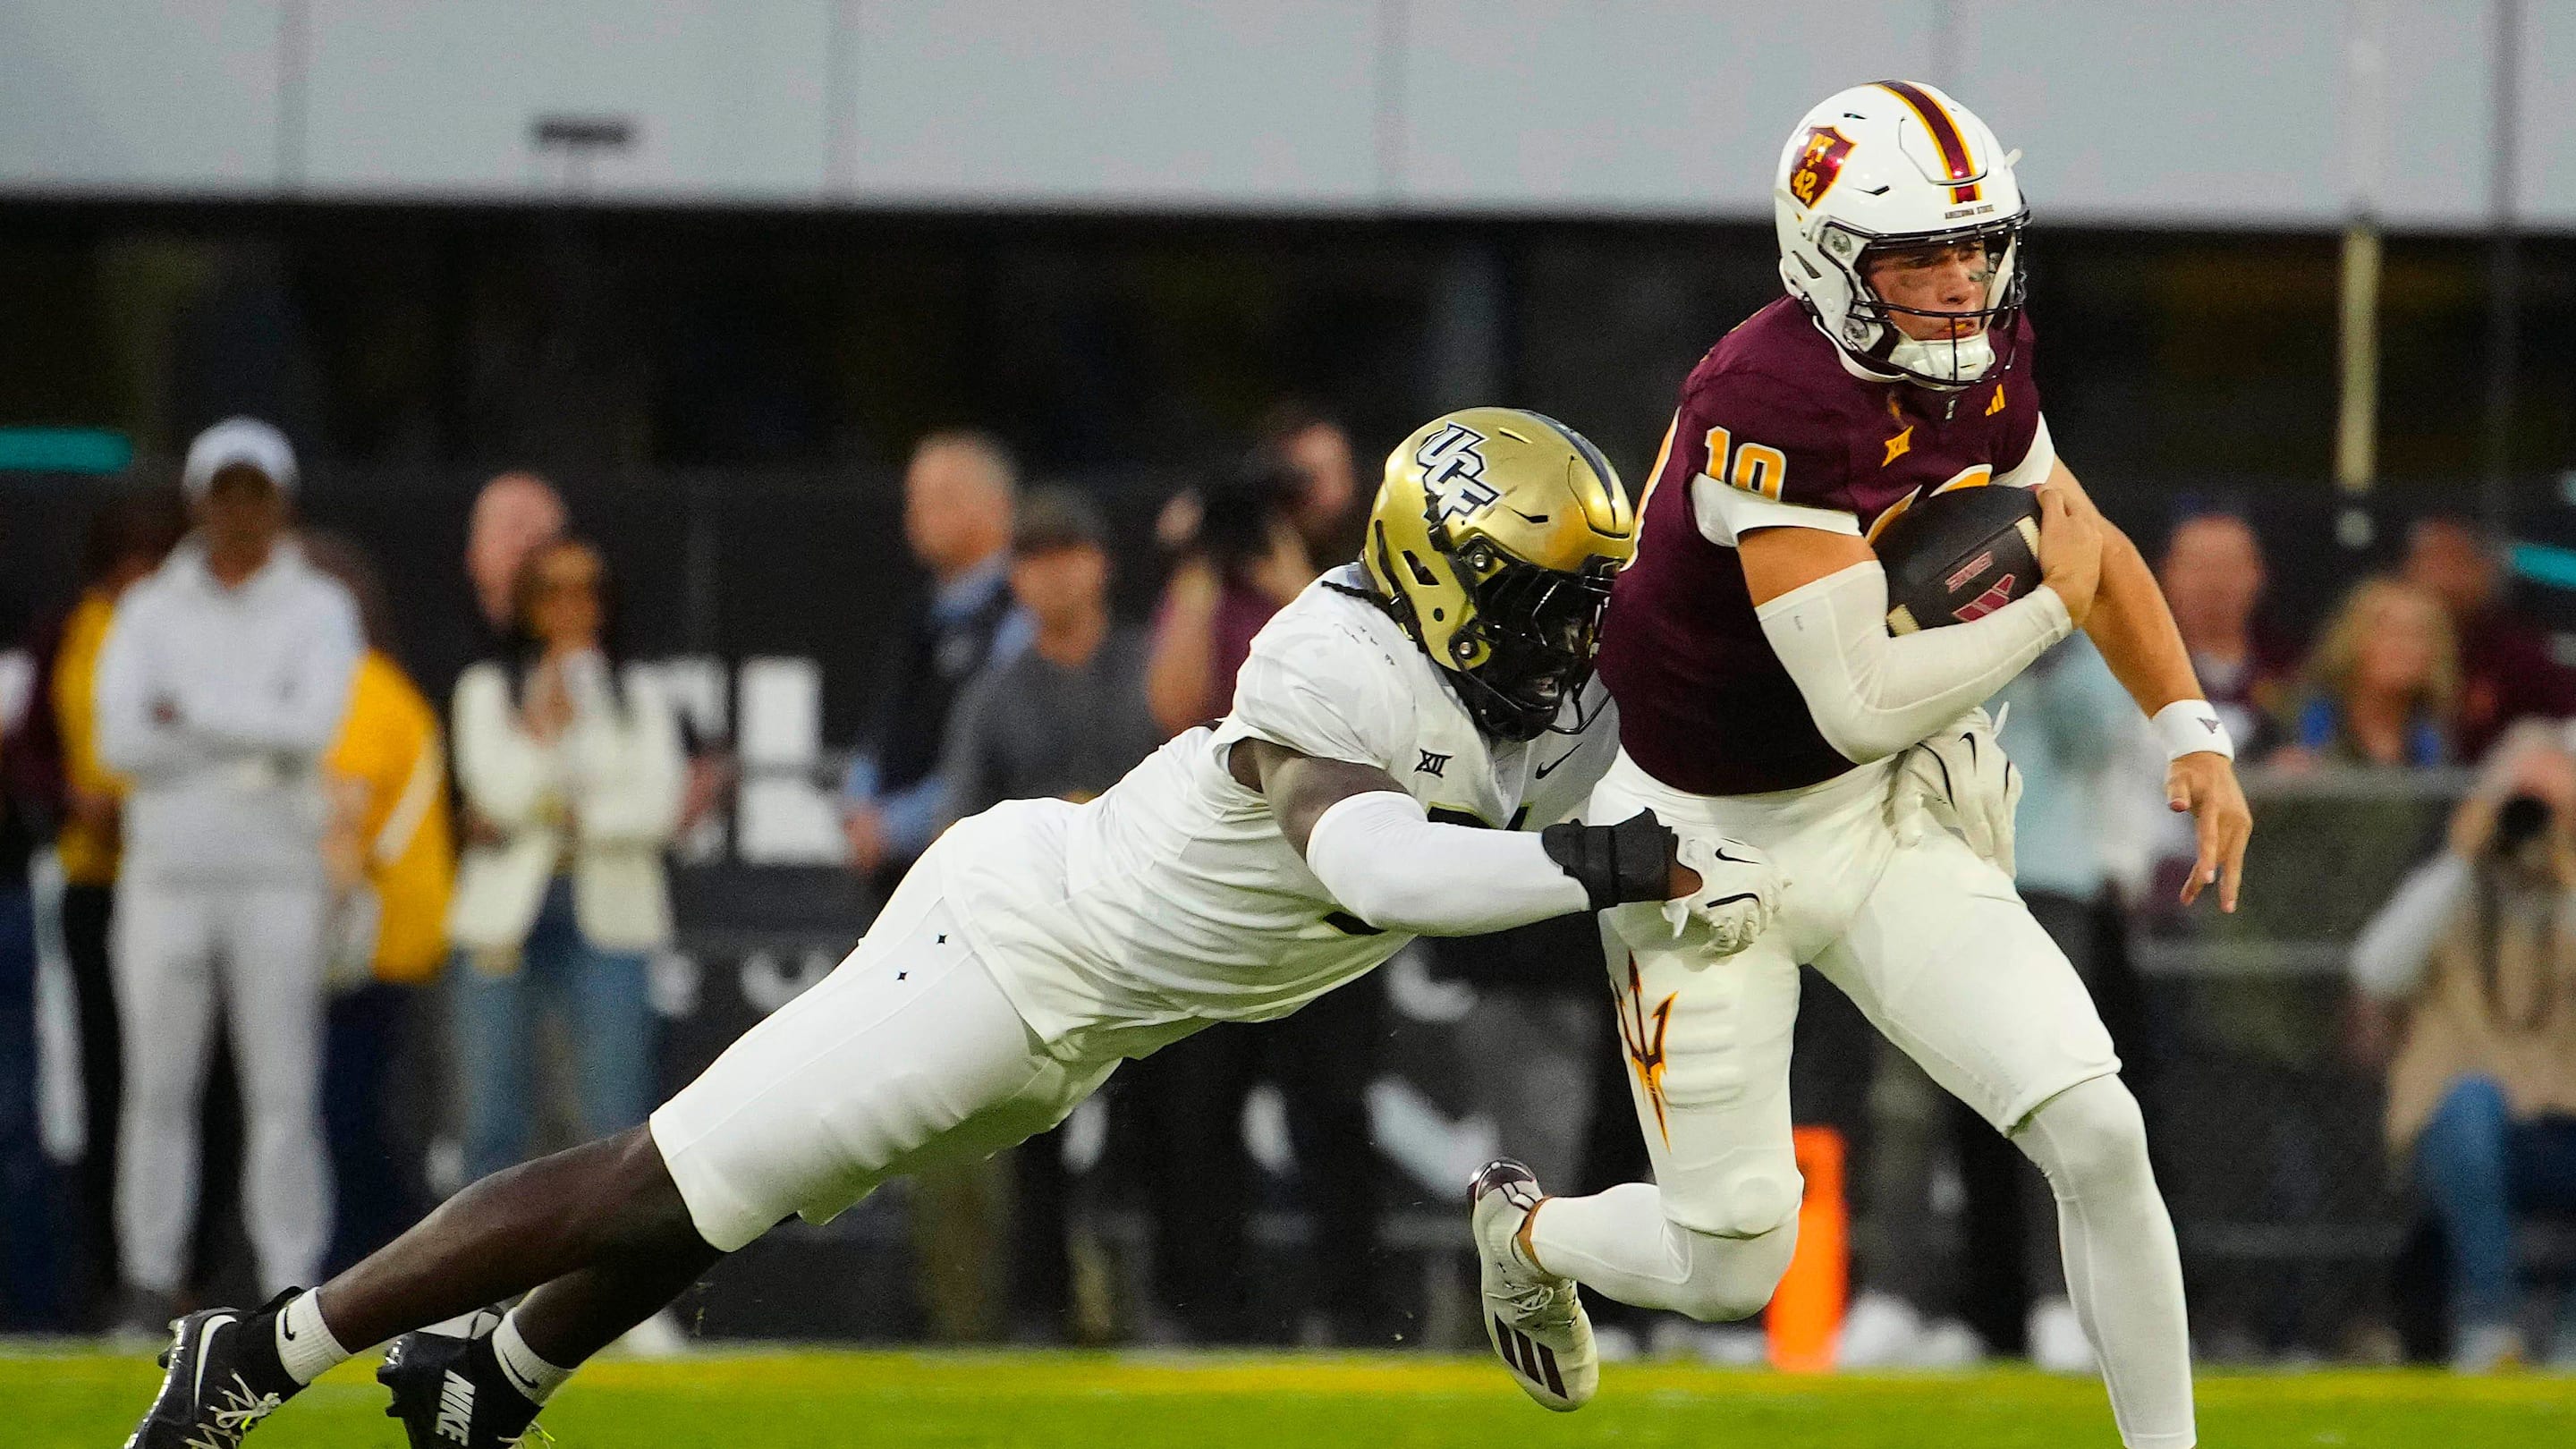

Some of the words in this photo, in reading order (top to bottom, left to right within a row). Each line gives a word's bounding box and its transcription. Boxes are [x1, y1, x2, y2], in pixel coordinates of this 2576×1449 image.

[1793, 168, 1818, 203] 42
[1415, 420, 1501, 522] UCF
[1705, 426, 1786, 502] 10
[1413, 749, 1454, 778] XII
[436, 1369, 476, 1447] NIKE
